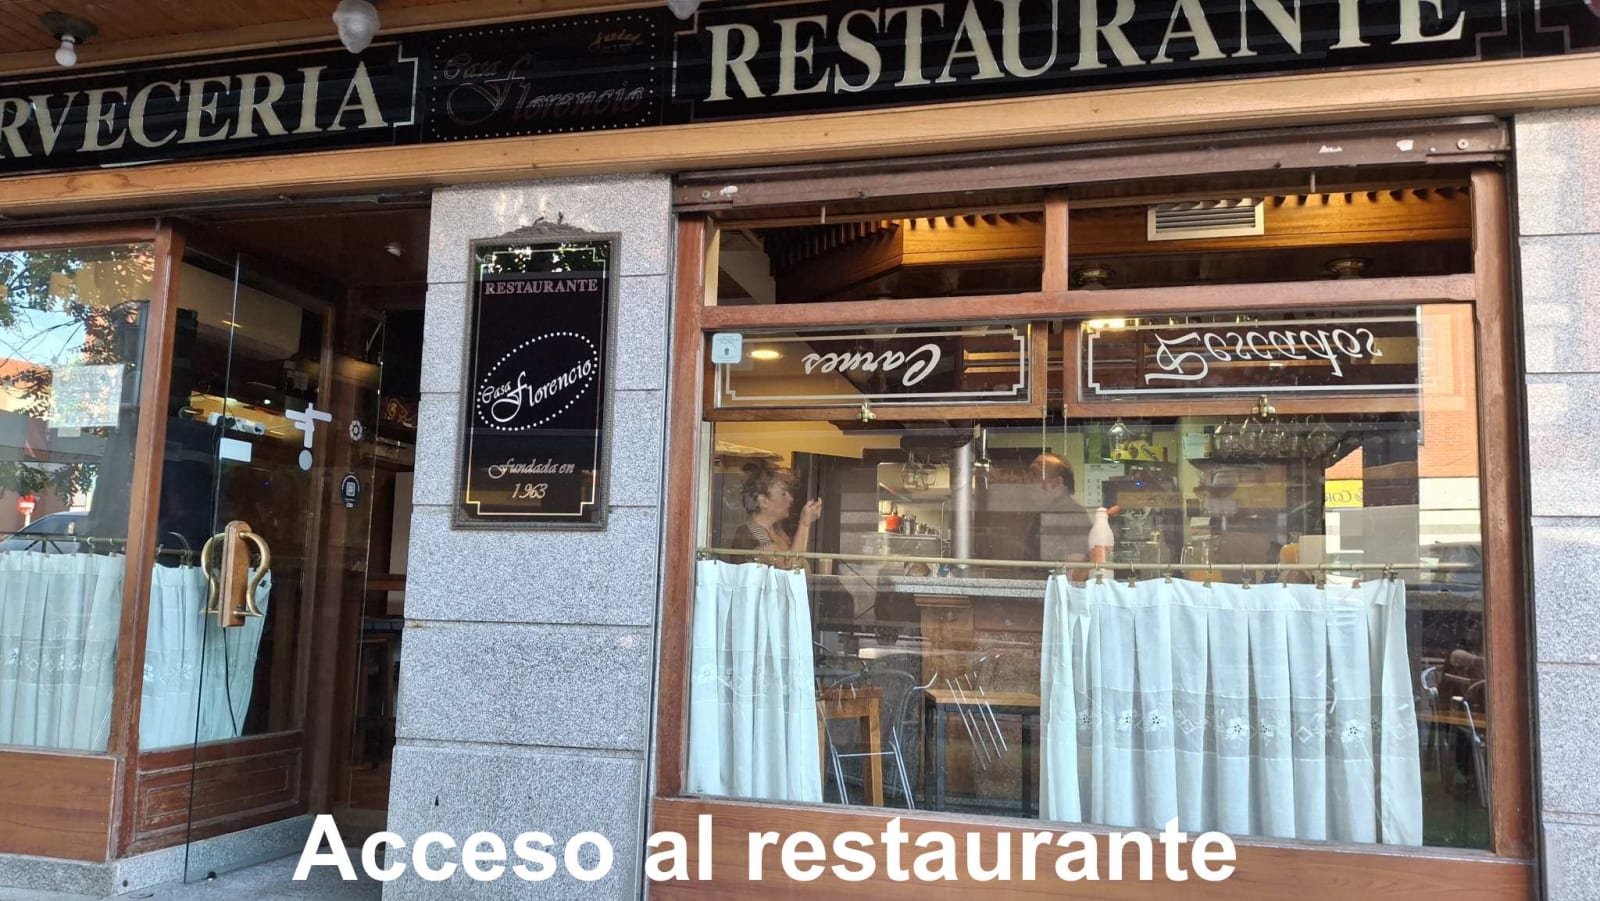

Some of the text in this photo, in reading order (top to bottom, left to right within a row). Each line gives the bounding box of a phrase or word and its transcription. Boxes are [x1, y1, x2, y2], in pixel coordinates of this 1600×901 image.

[485, 279, 598, 295] RESTAURANTE
[801, 343, 941, 387] Carnes
[482, 381, 512, 404] Casa
[491, 359, 591, 423] Florencio
[558, 463, 575, 474] en
